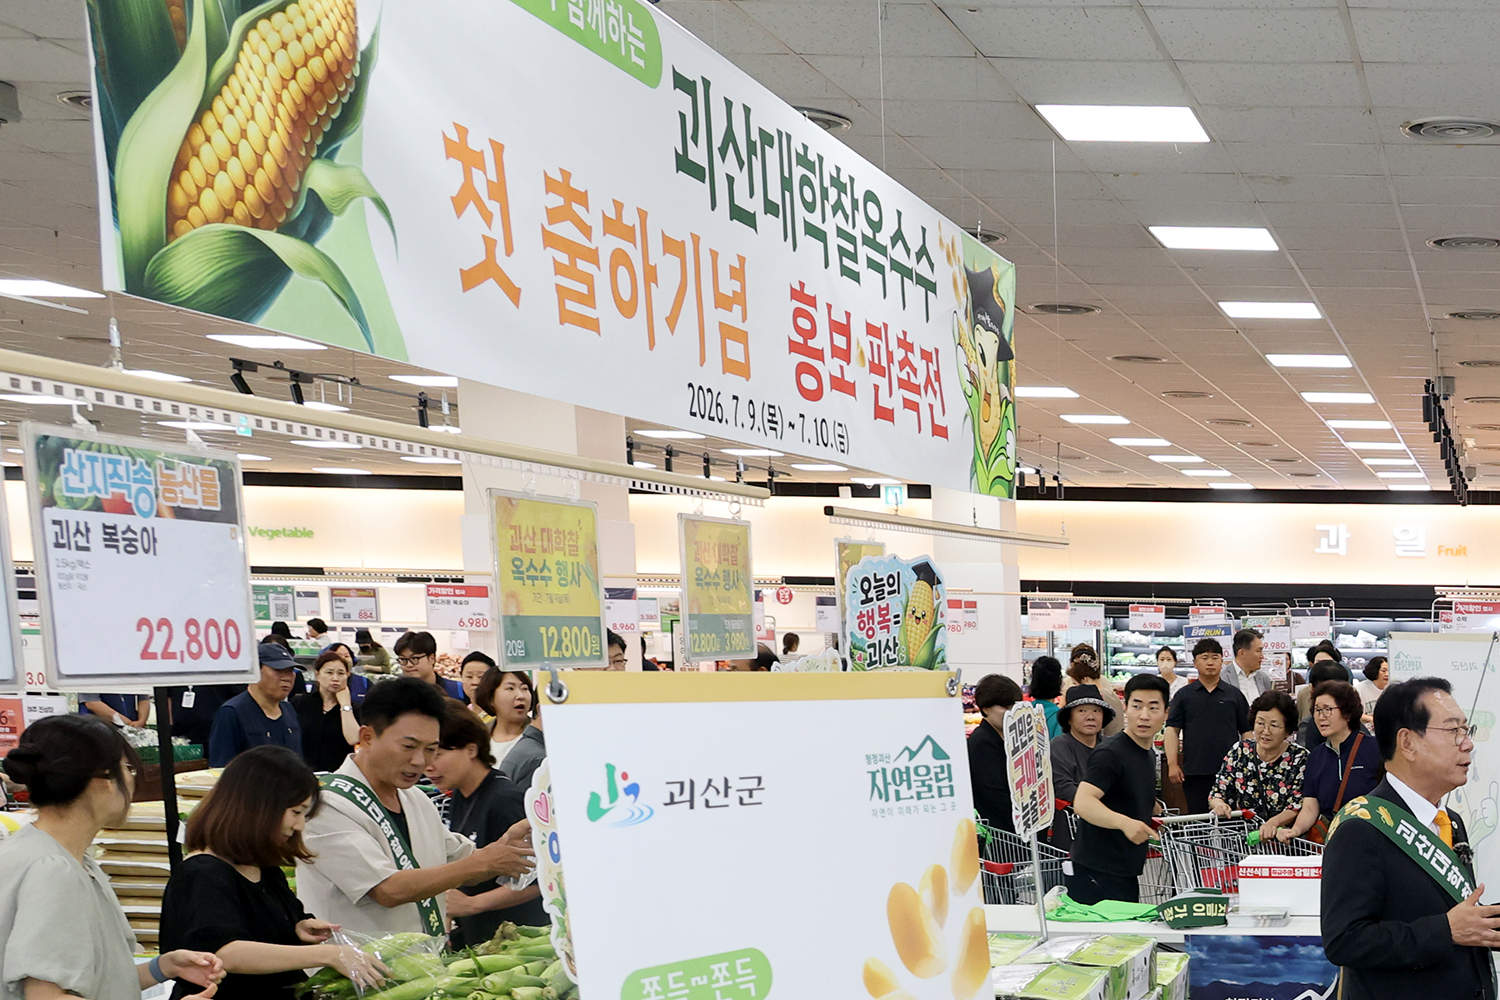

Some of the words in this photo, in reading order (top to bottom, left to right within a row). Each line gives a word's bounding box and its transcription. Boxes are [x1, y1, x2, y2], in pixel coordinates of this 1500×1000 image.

[672, 65, 937, 323] 괴산대학찰옥수수
[441, 121, 521, 309] 첫
[541, 167, 752, 381] 출하기념
[787, 280, 857, 402] 홍보
[865, 318, 949, 442] 판촉전
[63, 449, 155, 518] 산지직송
[158, 460, 221, 510] 농산물
[51, 519, 92, 552] 괴산
[101, 523, 158, 556] 복숭아
[248, 525, 315, 542] Vegetable
[509, 524, 536, 553] 괴산
[540, 527, 579, 557] 대학찰
[694, 540, 712, 565] 괴산
[712, 542, 739, 566] 대학찰
[1437, 544, 1468, 558] Fruit
[511, 556, 552, 587] 옥수수
[555, 560, 581, 588] 행사
[695, 567, 721, 592] 옥수수
[723, 569, 741, 591] 행사
[859, 571, 901, 605] 오늘의
[428, 586, 454, 596] 가격할인
[458, 617, 489, 629] 6,980
[612, 622, 636, 632] 8,960
[136, 617, 242, 663] 22,800
[505, 639, 526, 657] 20입
[866, 636, 899, 669] 괴산
[26, 671, 45, 687] 3,0
[1008, 712, 1035, 758] 고민은
[865, 752, 891, 765] 청정괴산
[1013, 744, 1043, 798] 구매만
[662, 775, 766, 811] 괴산군
[866, 763, 955, 803] 자연울림
[871, 807, 894, 819] 자연이
[898, 805, 920, 816] 미래가
[923, 804, 936, 814] 되는
[1239, 867, 1270, 877] 신선식품
